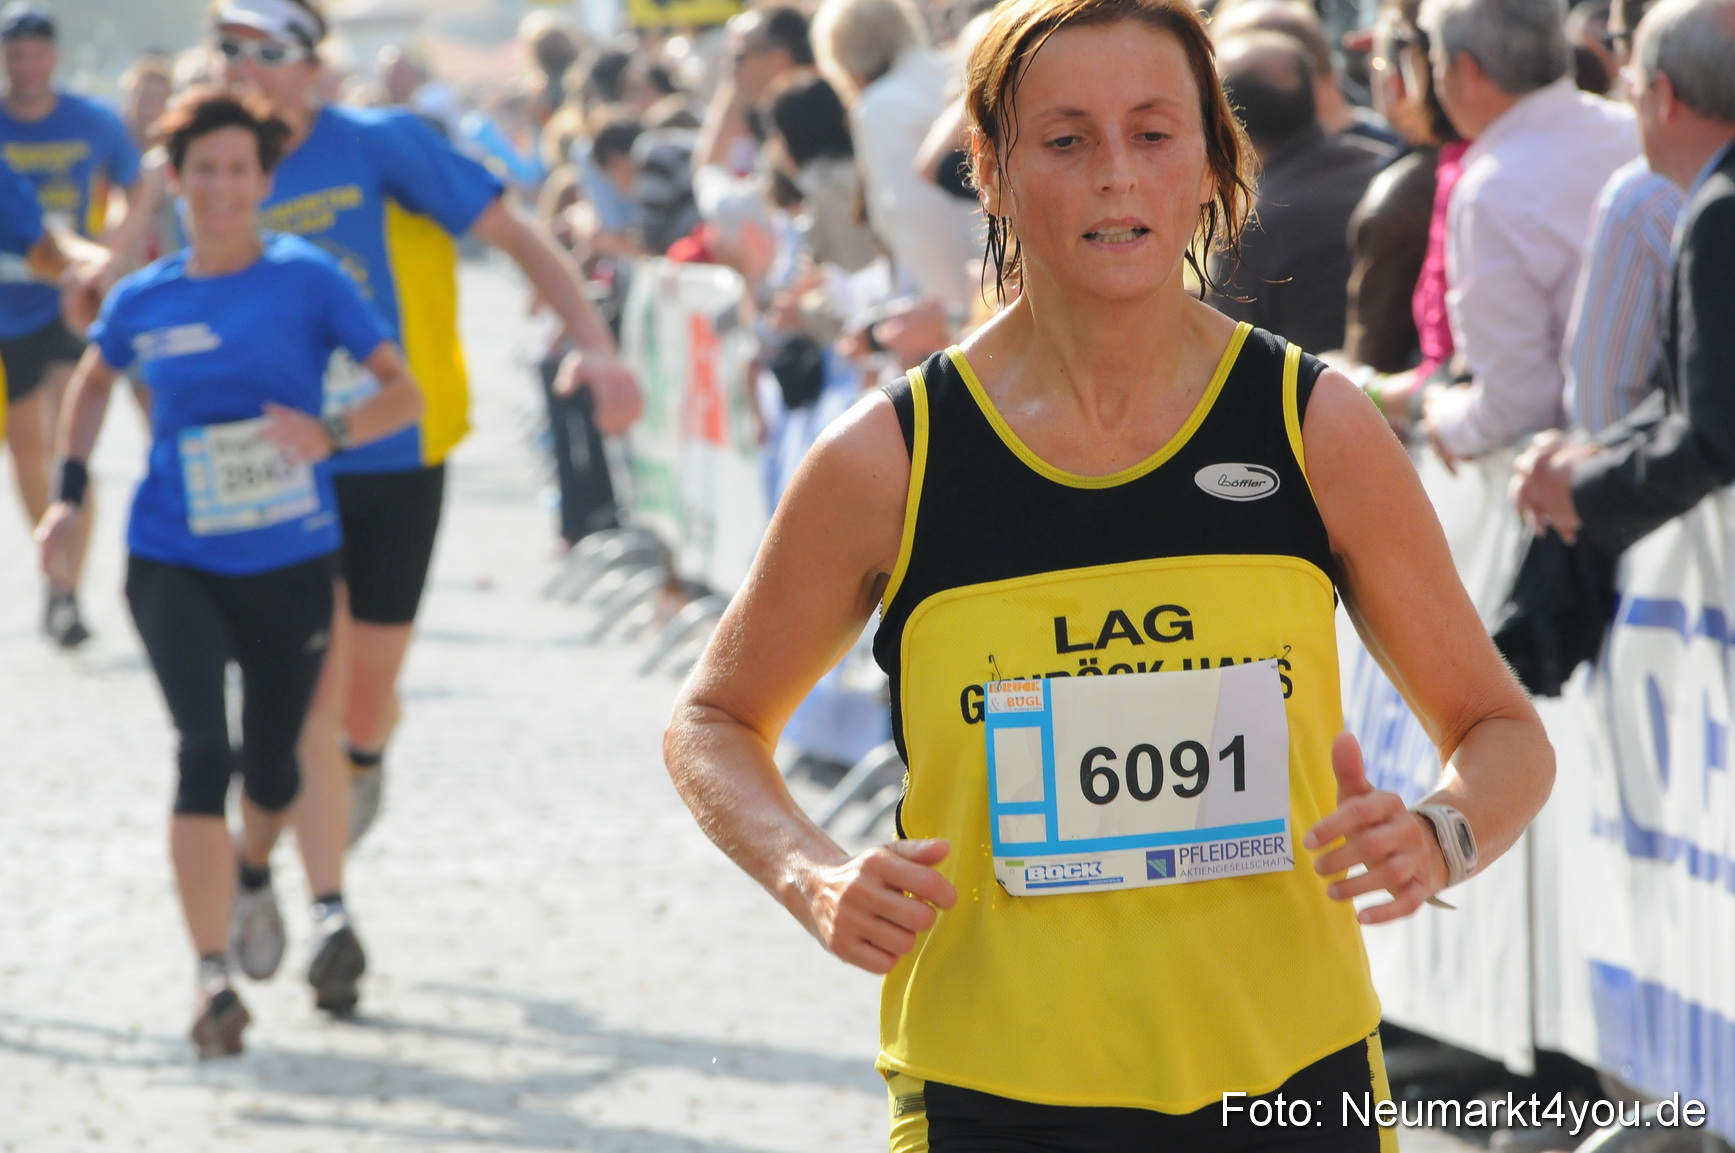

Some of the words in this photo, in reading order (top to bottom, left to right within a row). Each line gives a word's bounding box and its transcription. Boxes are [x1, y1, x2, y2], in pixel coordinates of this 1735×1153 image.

[1053, 603, 1195, 655] LAG
[1079, 734, 1246, 806] 6091
[1178, 835, 1286, 866] PFLEIDERER
[1025, 860, 1103, 882] BOCK
[1180, 857, 1287, 878] AKTIENGESELLSCHAFT
